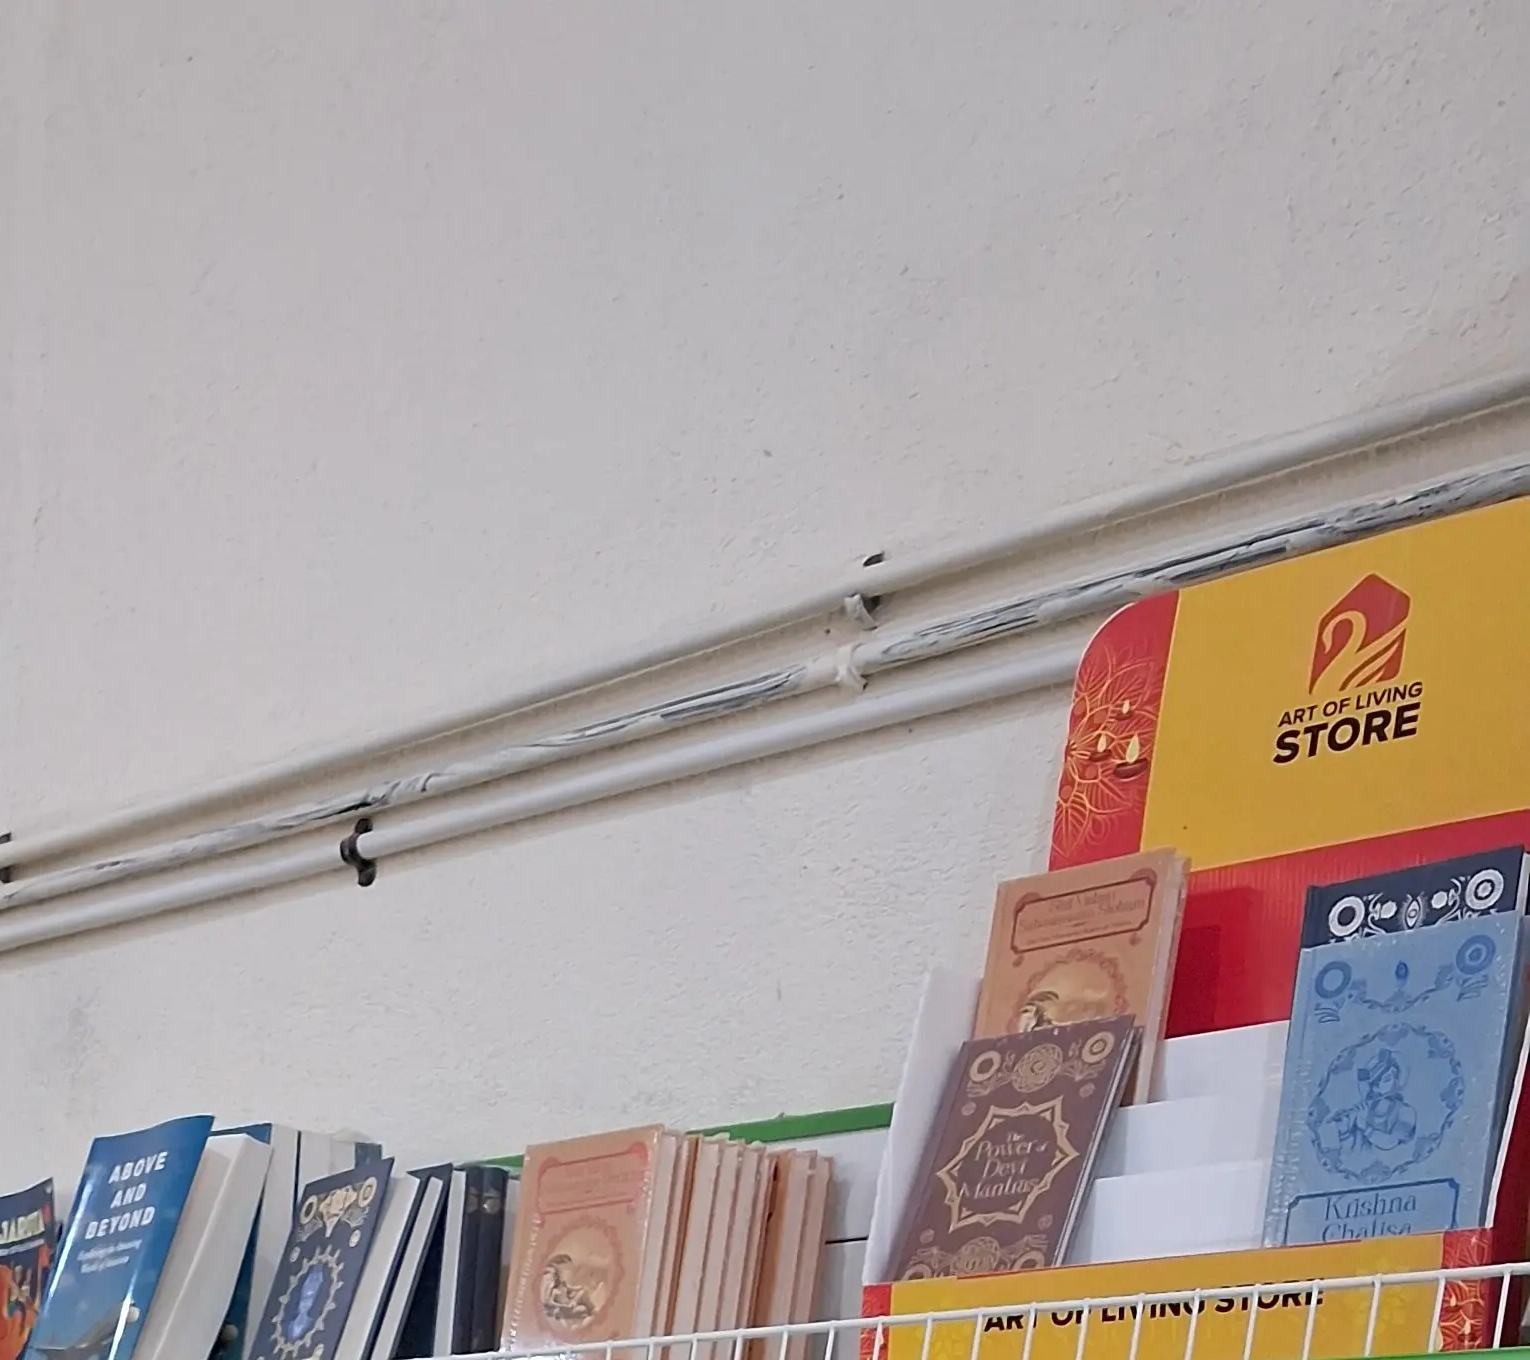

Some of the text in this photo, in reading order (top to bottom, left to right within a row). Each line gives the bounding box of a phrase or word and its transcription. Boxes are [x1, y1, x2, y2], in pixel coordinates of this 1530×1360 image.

[1278, 681, 1424, 727] ART OF LIVING
[1271, 701, 1422, 764] STORE
[974, 1139, 1035, 1161] Power
[108, 1151, 168, 1184] ABOVE
[981, 1158, 1029, 1179] Devi
[110, 1184, 146, 1209] AND
[1325, 1192, 1417, 1221] Krishna
[85, 1207, 155, 1241] BEYOND
